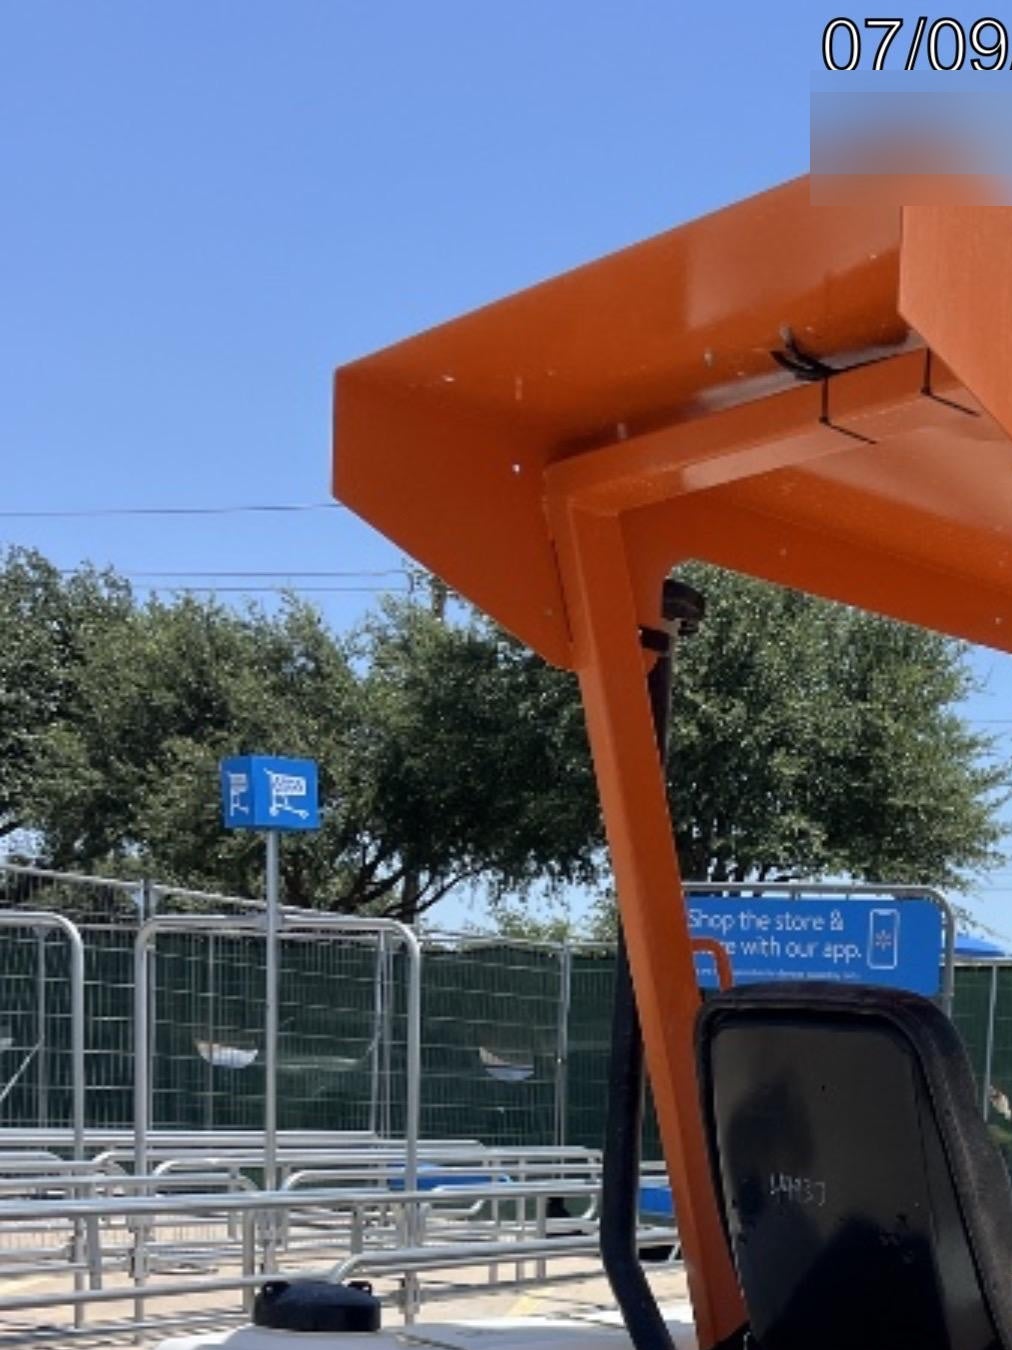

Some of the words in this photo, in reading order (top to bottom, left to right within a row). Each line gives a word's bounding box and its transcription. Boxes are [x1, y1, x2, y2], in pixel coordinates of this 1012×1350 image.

[688, 908, 735, 936] Shop
[740, 911, 771, 931] the
[775, 911, 825, 931] store
[829, 908, 844, 931] &
[740, 935, 781, 958] with
[785, 941, 818, 958] our
[822, 942, 862, 964] app.
